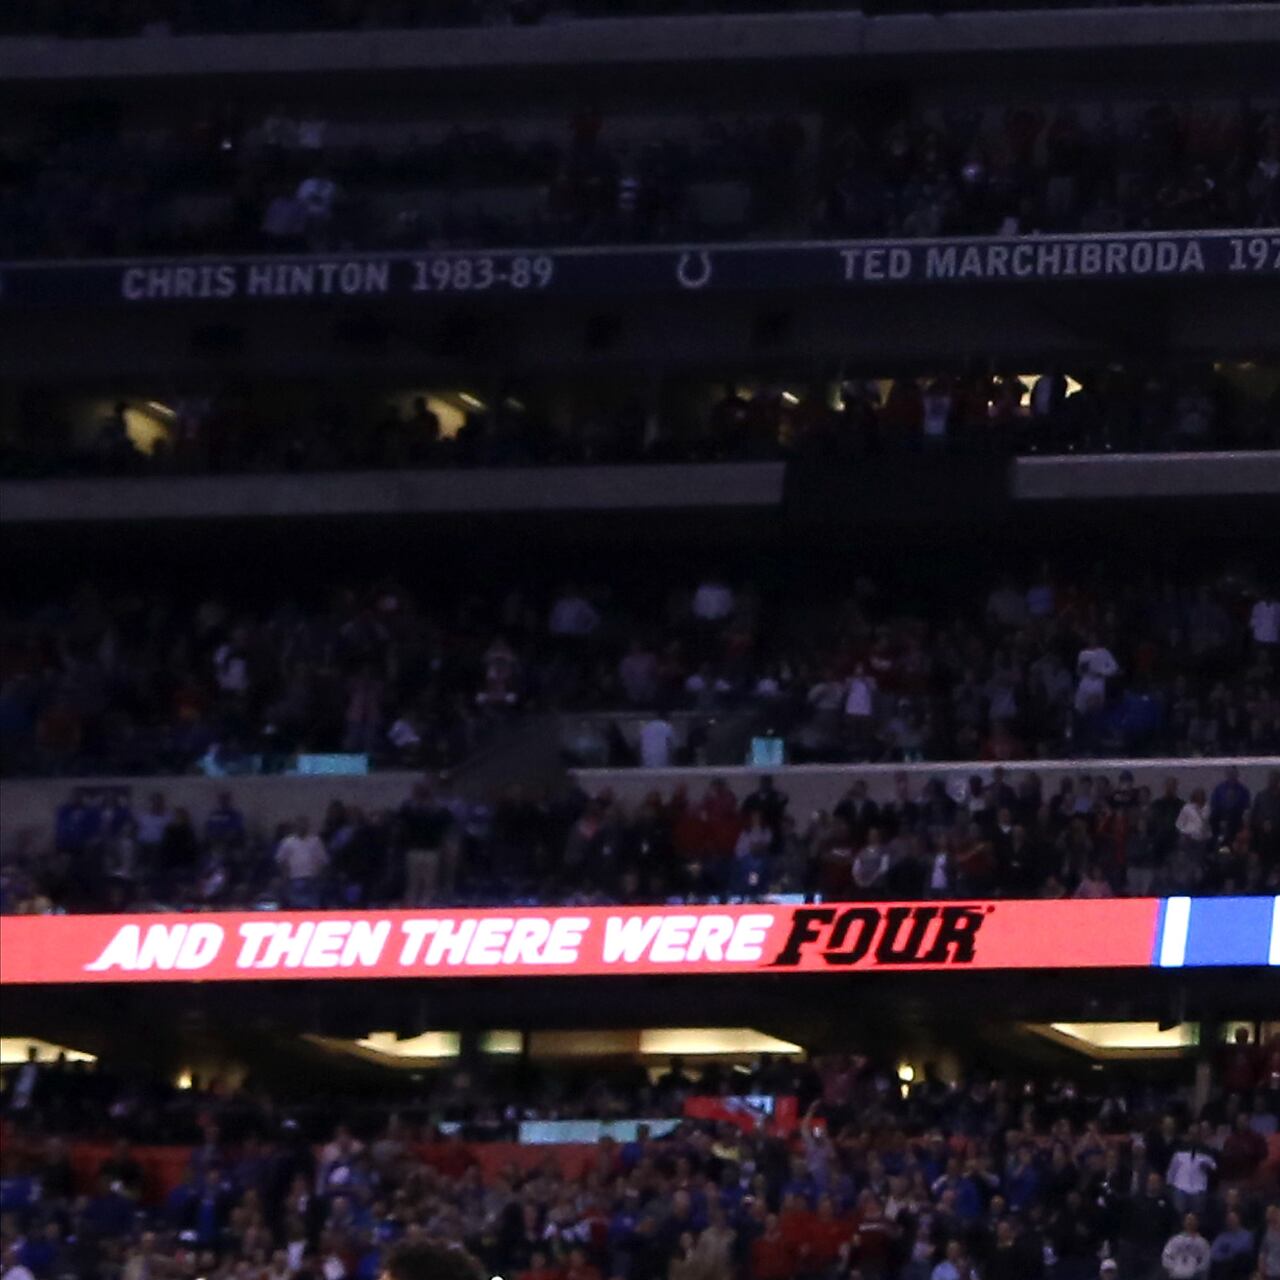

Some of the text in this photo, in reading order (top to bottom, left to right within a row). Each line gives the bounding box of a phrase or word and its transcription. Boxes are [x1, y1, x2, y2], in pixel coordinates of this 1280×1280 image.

[121, 256, 553, 299] CHRIS HINTON 1983-89
[840, 247, 911, 280] TED
[925, 240, 1206, 277] MARCHIBRODA
[85, 906, 986, 972] AND THEN THERE WERE FOUR
